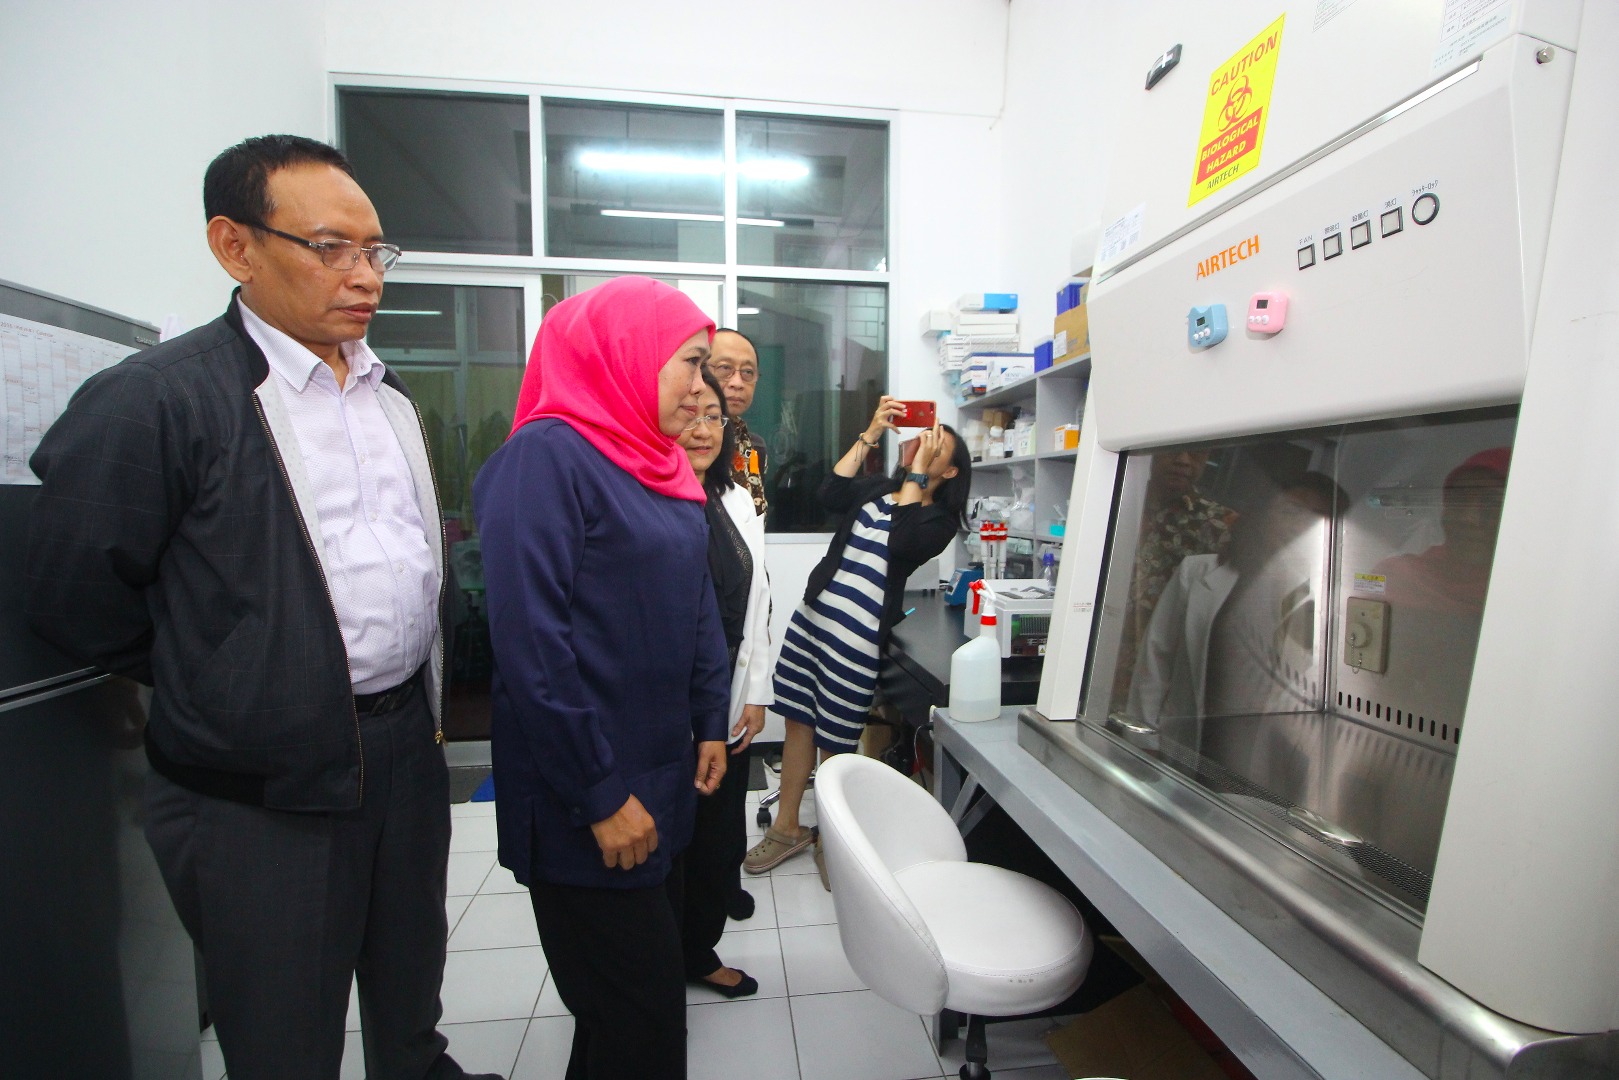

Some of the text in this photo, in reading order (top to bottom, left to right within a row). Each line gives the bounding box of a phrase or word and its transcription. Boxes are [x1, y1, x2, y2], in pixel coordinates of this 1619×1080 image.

[1211, 30, 1278, 96] CAUTION
[1201, 116, 1258, 161] BIOLOGICAL
[1206, 141, 1246, 174] HAZARD
[1206, 164, 1240, 189] AIRTECH
[1196, 234, 1260, 280] AIRTECH
